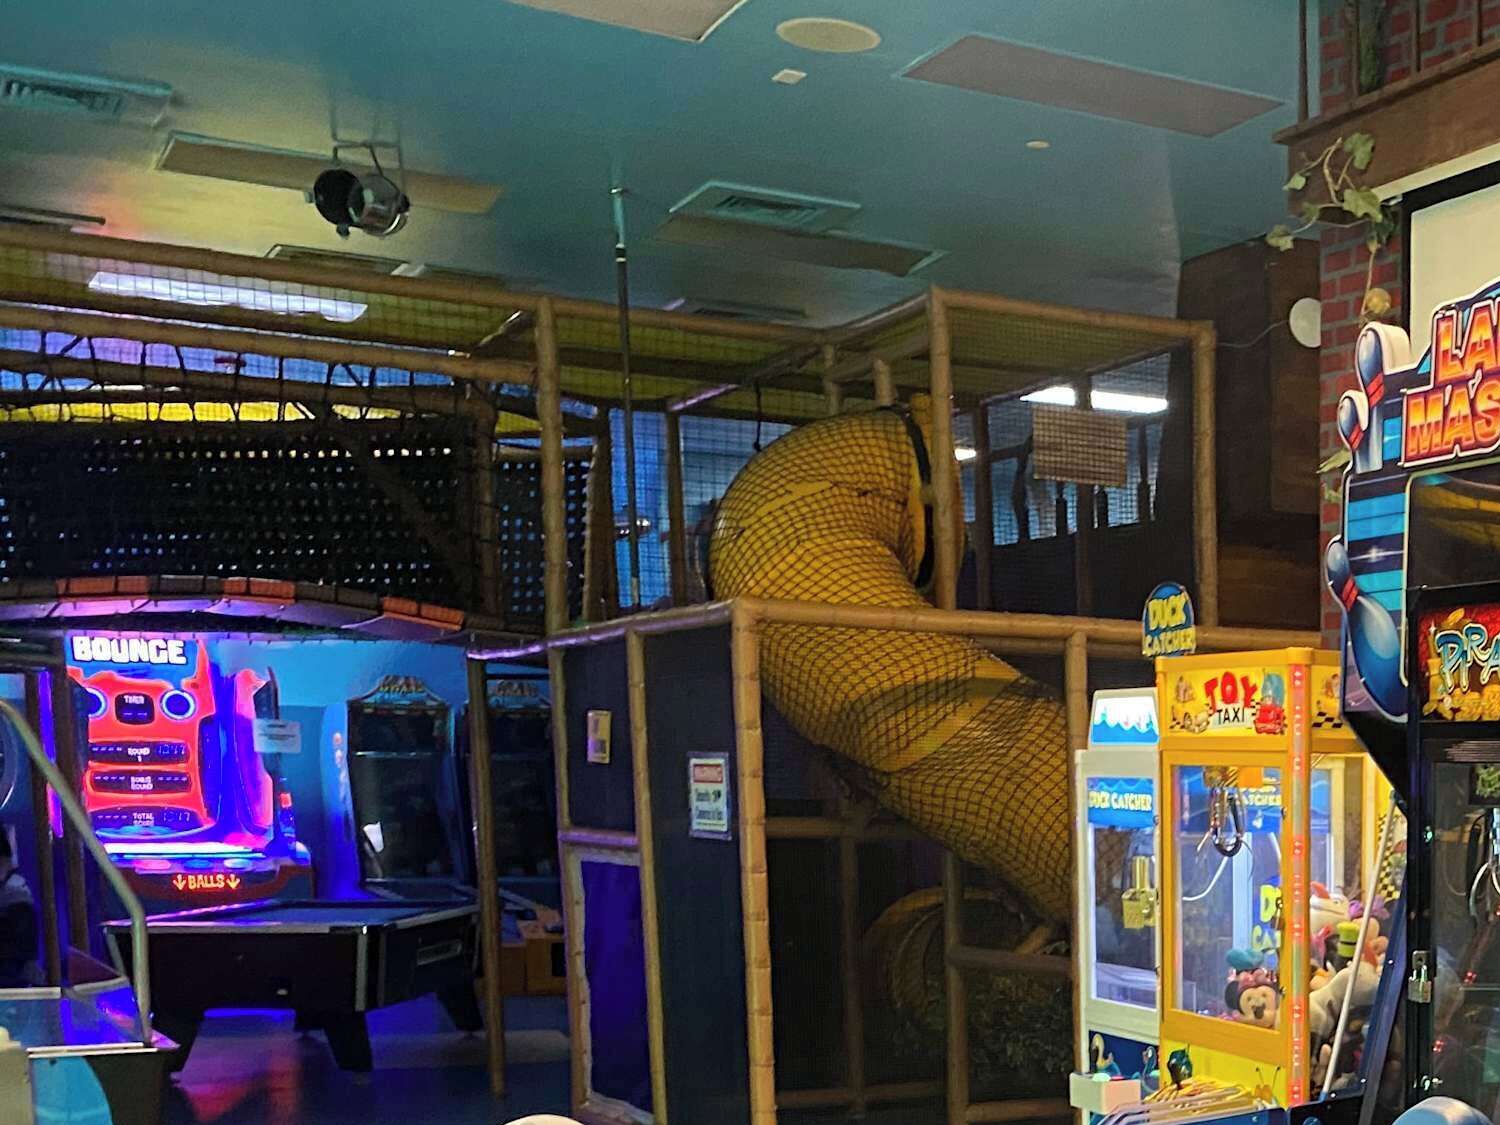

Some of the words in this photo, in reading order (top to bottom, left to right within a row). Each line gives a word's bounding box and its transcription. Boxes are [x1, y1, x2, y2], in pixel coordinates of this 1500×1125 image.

[1148, 592, 1188, 630] DUCK
[72, 635, 187, 664] BOUNCE
[1143, 626, 1196, 656] CATCHER
[1204, 671, 1259, 714] TOY
[1216, 707, 1246, 725] TAXI
[188, 874, 225, 889] BALLS
